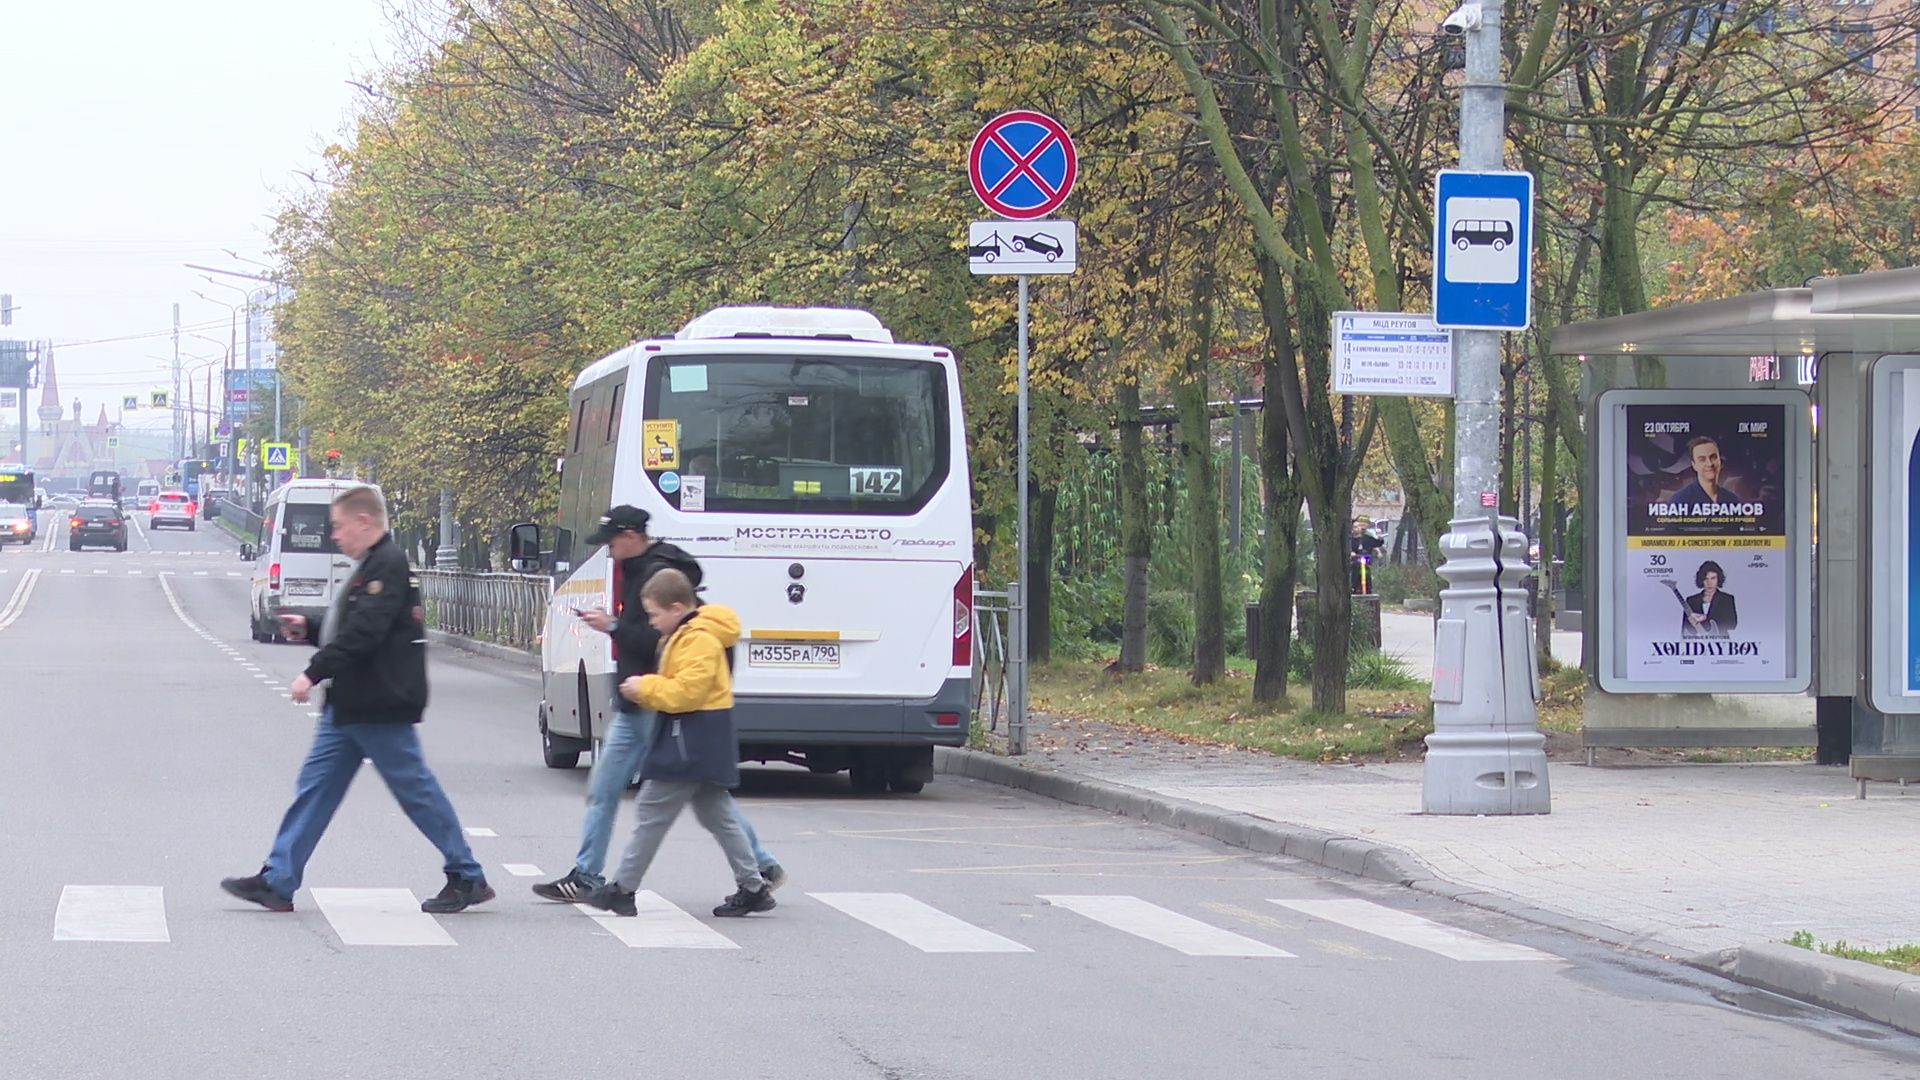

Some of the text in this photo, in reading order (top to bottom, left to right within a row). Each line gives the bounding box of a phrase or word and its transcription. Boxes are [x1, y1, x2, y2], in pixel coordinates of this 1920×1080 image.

[1391, 320, 1416, 328] РЕУТОВ
[1344, 342, 1351, 354] 14
[1644, 422, 1690, 433] 23 ОКТЯБРЯ
[1738, 422, 1768, 433] ДК МИР
[852, 471, 901, 495] 142
[1649, 503, 1764, 516] ИВАН АБРАМОВ
[736, 527, 892, 541] МОСТРАНСАВТО
[1650, 555, 1666, 566] 30
[754, 646, 835, 661] М355РА 790
